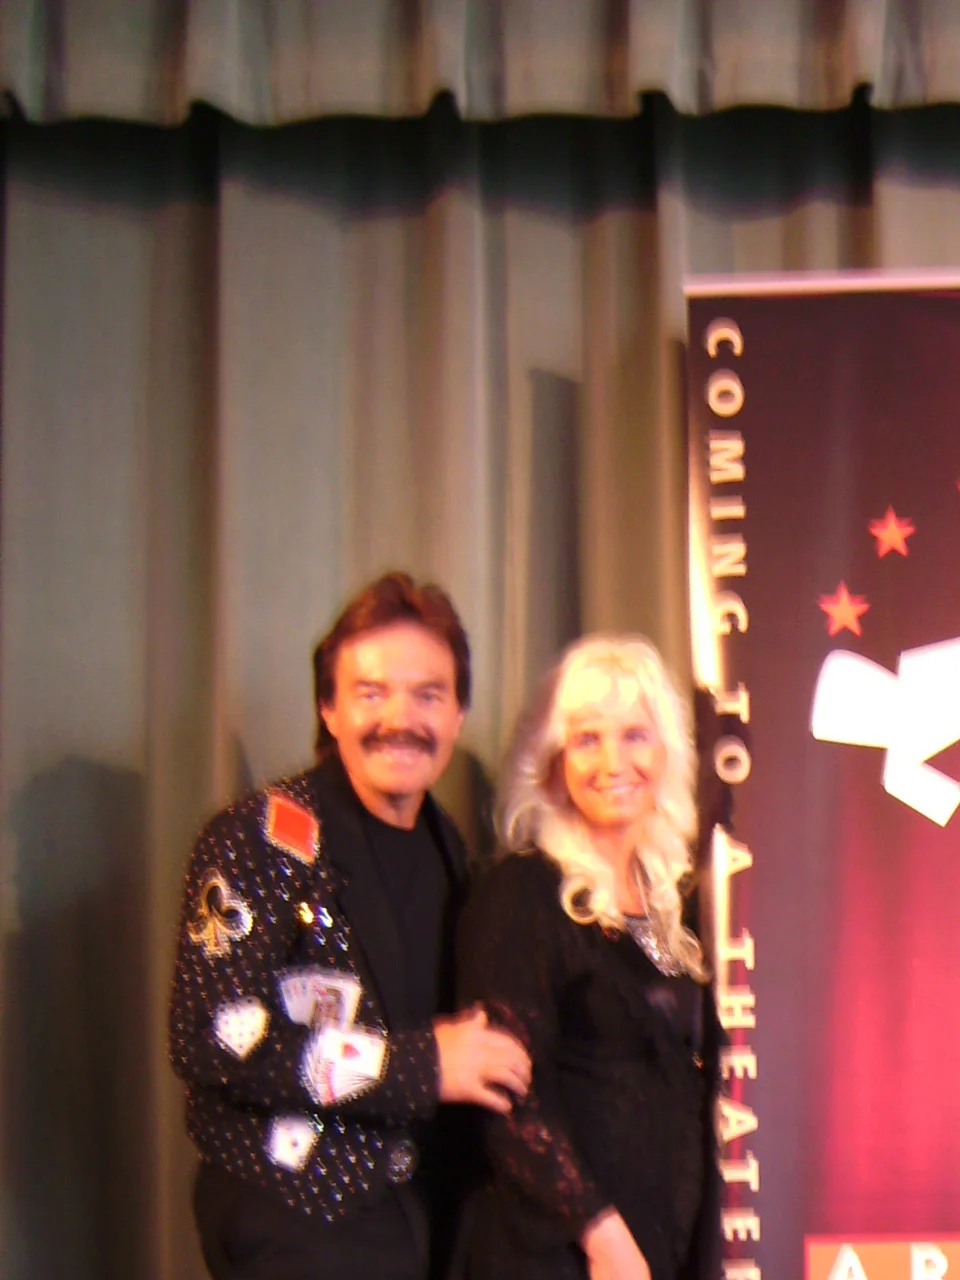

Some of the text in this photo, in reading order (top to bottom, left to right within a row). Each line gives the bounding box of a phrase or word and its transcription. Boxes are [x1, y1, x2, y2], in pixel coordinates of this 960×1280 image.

[707, 317, 748, 636] COMING
[715, 682, 750, 785] TO
[715, 825, 753, 876] A
